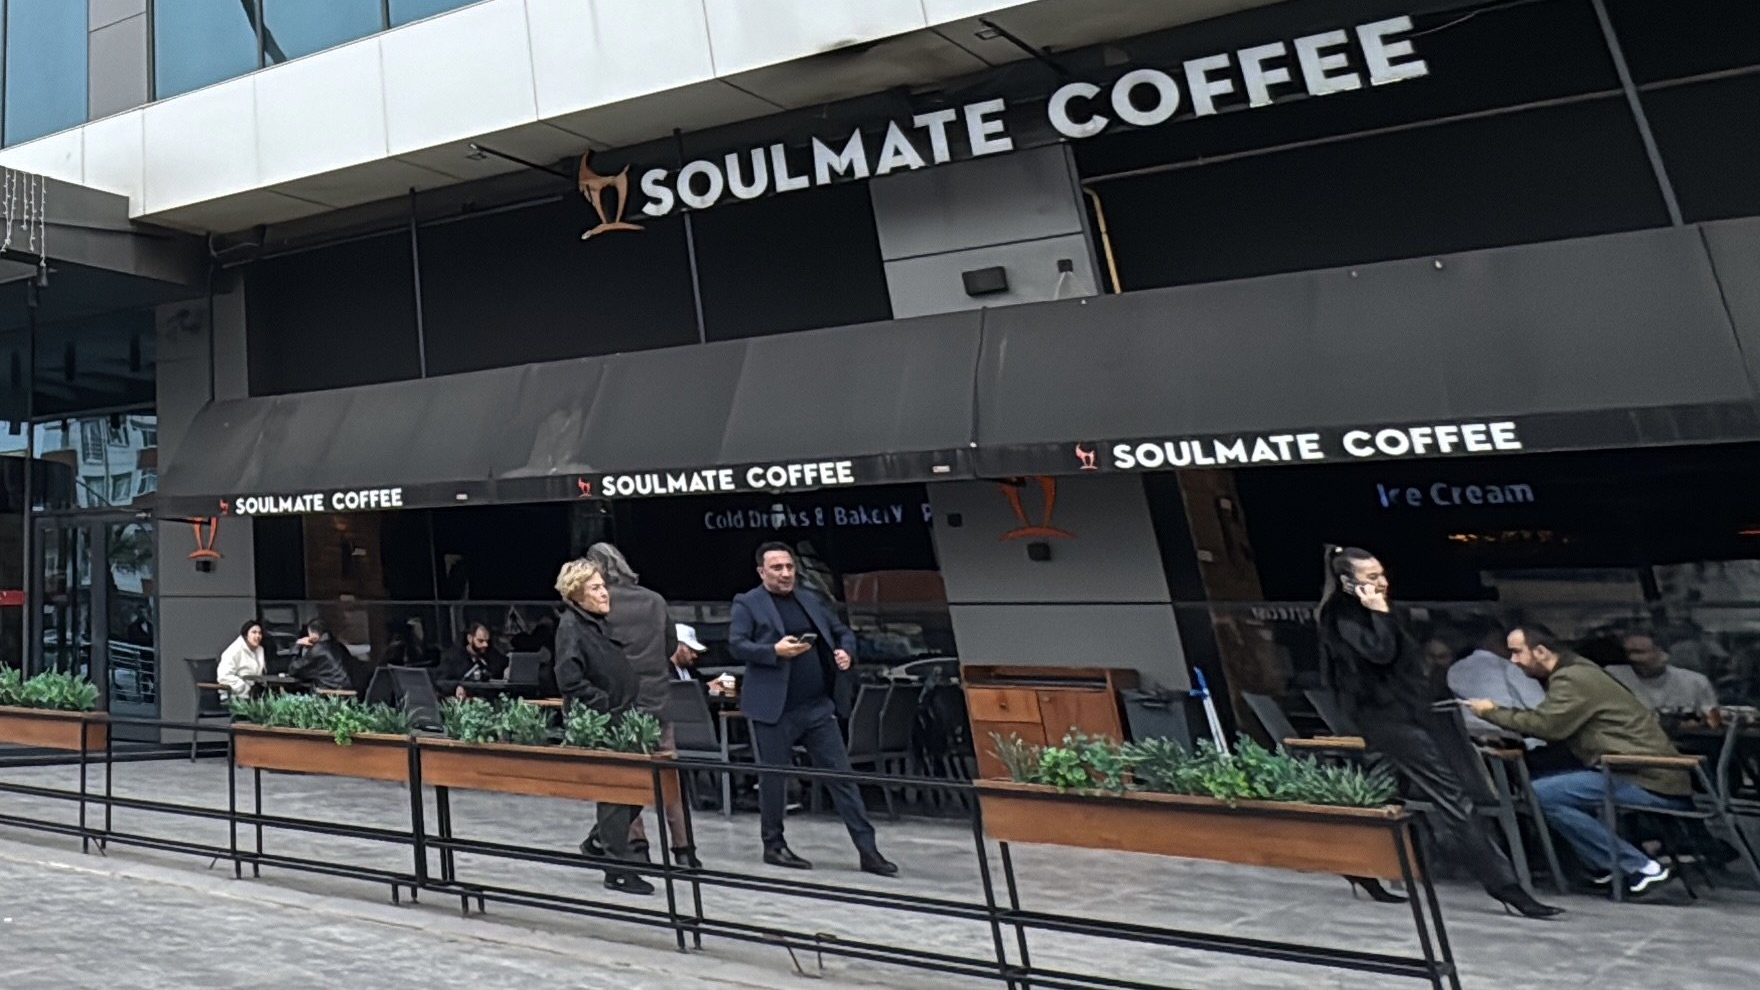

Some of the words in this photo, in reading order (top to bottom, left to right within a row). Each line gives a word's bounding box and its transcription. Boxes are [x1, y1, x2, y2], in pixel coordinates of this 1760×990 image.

[639, 98, 1016, 218] SOULMATE
[1047, 15, 1431, 140] COFFEE
[1113, 433, 1325, 471] SOULMATE
[1343, 421, 1524, 459] COFFEE
[601, 468, 736, 497] SOULMATE
[746, 460, 856, 490] COFFEE
[1430, 481, 1535, 506] Cream
[235, 493, 325, 516] SOULMATE
[331, 487, 403, 511] COFFEE
[705, 511, 745, 530] Cold
